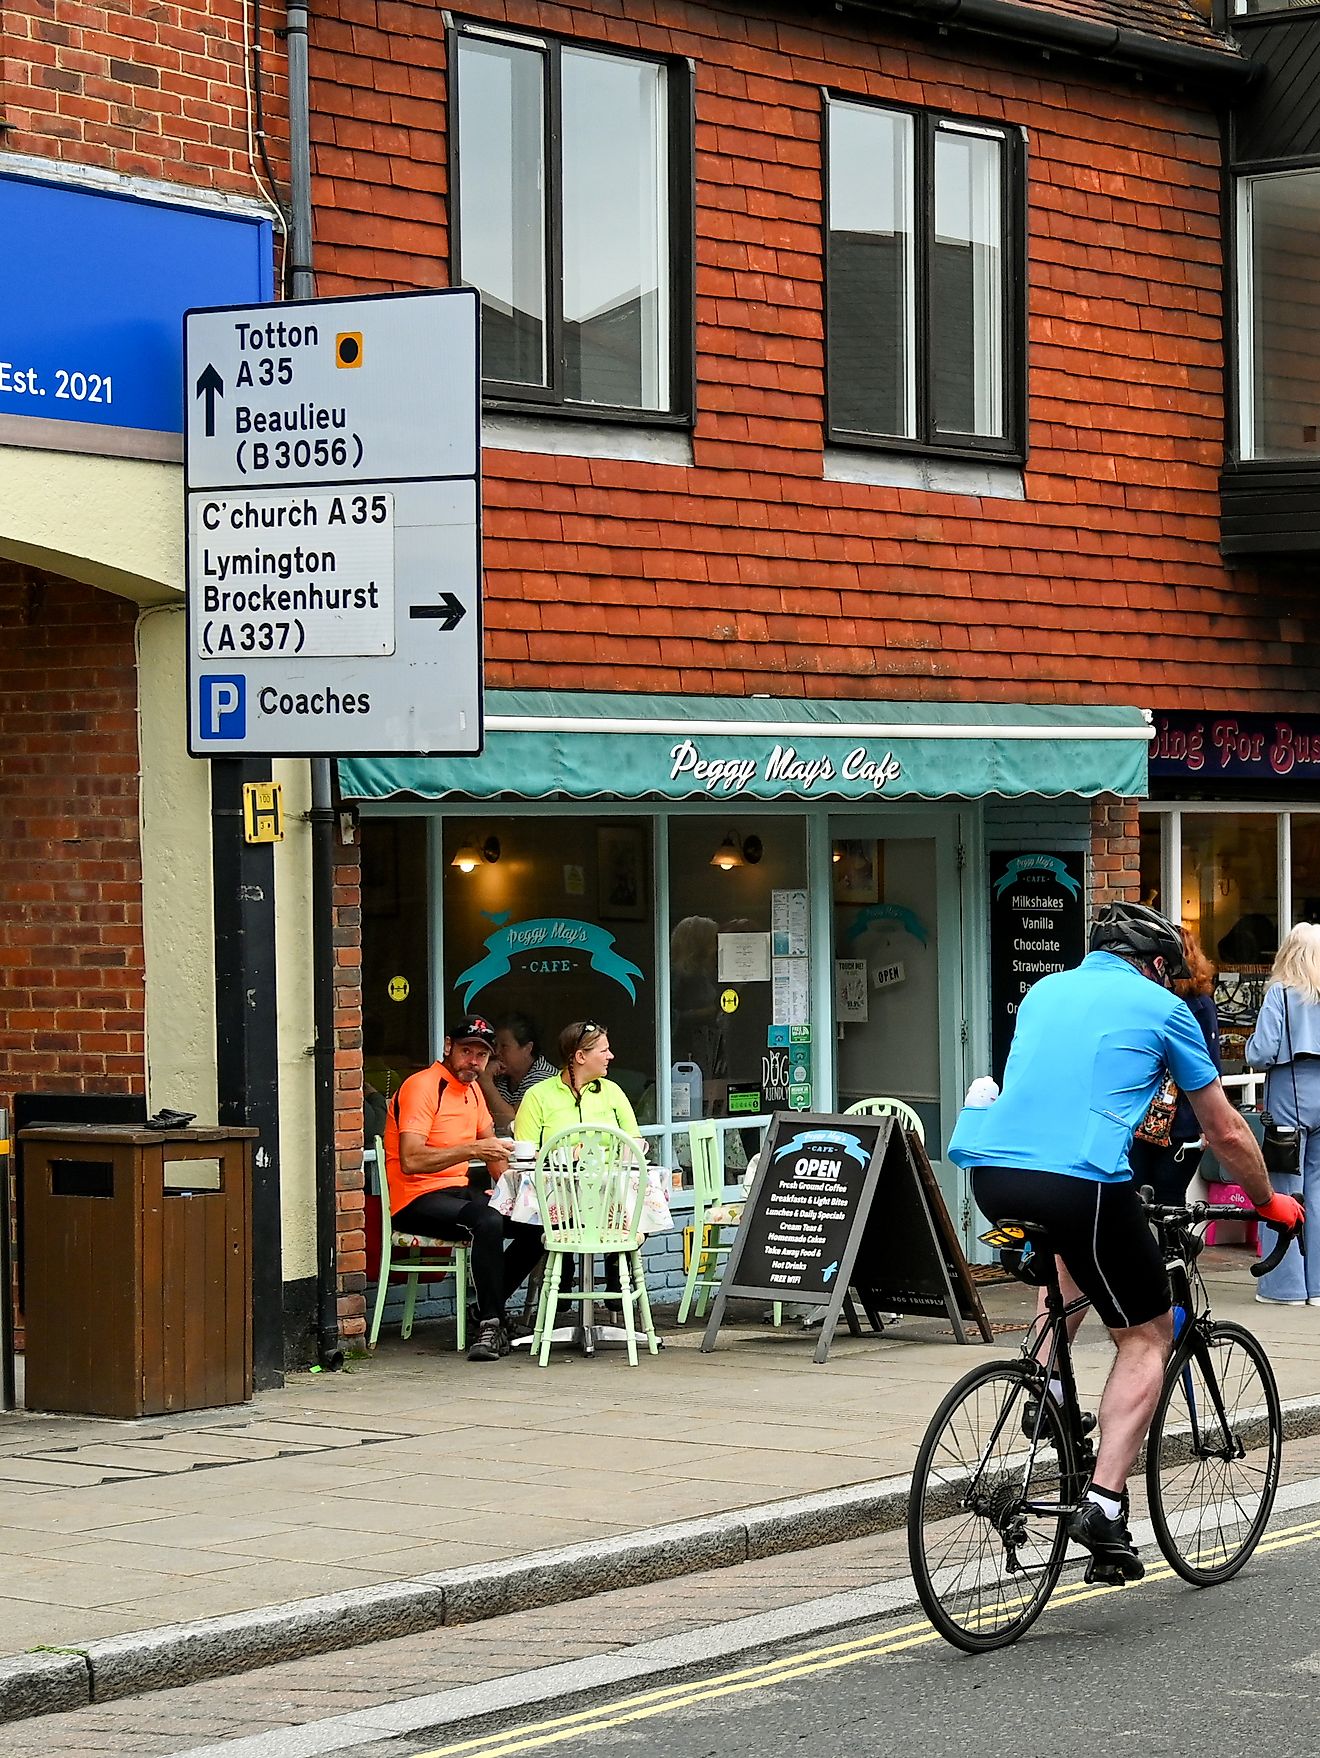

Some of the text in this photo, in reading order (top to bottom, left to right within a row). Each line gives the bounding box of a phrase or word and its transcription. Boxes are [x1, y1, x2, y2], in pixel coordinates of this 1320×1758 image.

[235, 322, 318, 350] Totton
[0, 362, 112, 403] Est. 2021
[236, 358, 293, 387] A35
[236, 403, 346, 433] Beaulieu
[236, 433, 363, 474] (B3056)
[203, 496, 387, 530] C'church A35
[204, 546, 336, 580] Lymington
[204, 581, 379, 612] Brockenhurst
[203, 619, 305, 655] (A337)
[211, 682, 239, 733] P
[259, 687, 370, 714] Coaches
[1212, 719, 1264, 769] For
[670, 739, 901, 790] Peggy May's Cafe
[251, 788, 279, 837] H
[1012, 896, 1064, 909] Milkshakes
[550, 922, 588, 943] May's
[1022, 917, 1054, 930] Vanilla
[1014, 938, 1060, 952] Chocolate
[878, 966, 900, 984] OPEN
[1012, 959, 1065, 973] Strawberry
[794, 1157, 842, 1178] OPEN
[779, 1180, 848, 1193] Fresh Ground Coffee
[770, 1193, 849, 1207] Breakfasts & Light Bites
[765, 1207, 846, 1221] Lunches & Daily Specials
[779, 1222, 823, 1232] Cream Teas &
[767, 1232, 826, 1244] Homemade Cakes
[764, 1245, 822, 1259] Take Away Food &
[771, 1260, 808, 1270] Hot Drinks
[770, 1273, 787, 1283] FREE
